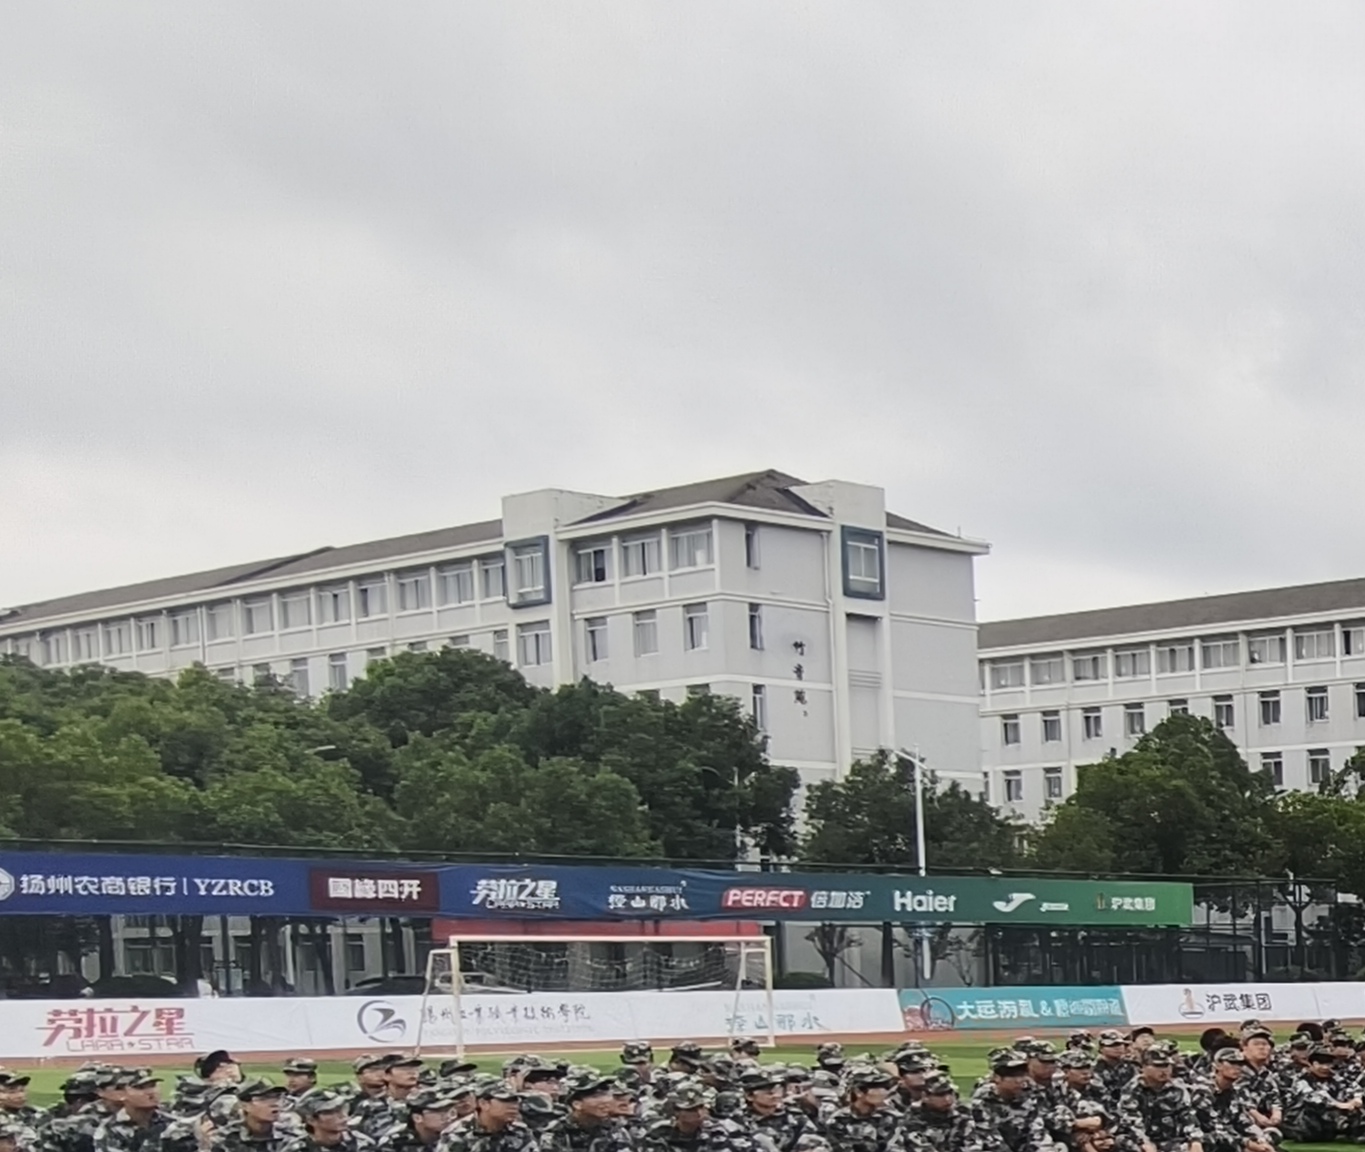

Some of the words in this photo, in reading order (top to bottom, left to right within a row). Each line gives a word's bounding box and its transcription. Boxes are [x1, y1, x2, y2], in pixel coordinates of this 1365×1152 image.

[19, 873, 177, 896] 扬州农商银行
[192, 877, 275, 897] YZRCB
[469, 878, 560, 905] 劳拉之星
[810, 890, 866, 909] 倍加洁
[894, 889, 957, 913] Haier
[1206, 993, 1272, 1012] 沪武集团
[36, 1005, 194, 1046] 劳拉之星
